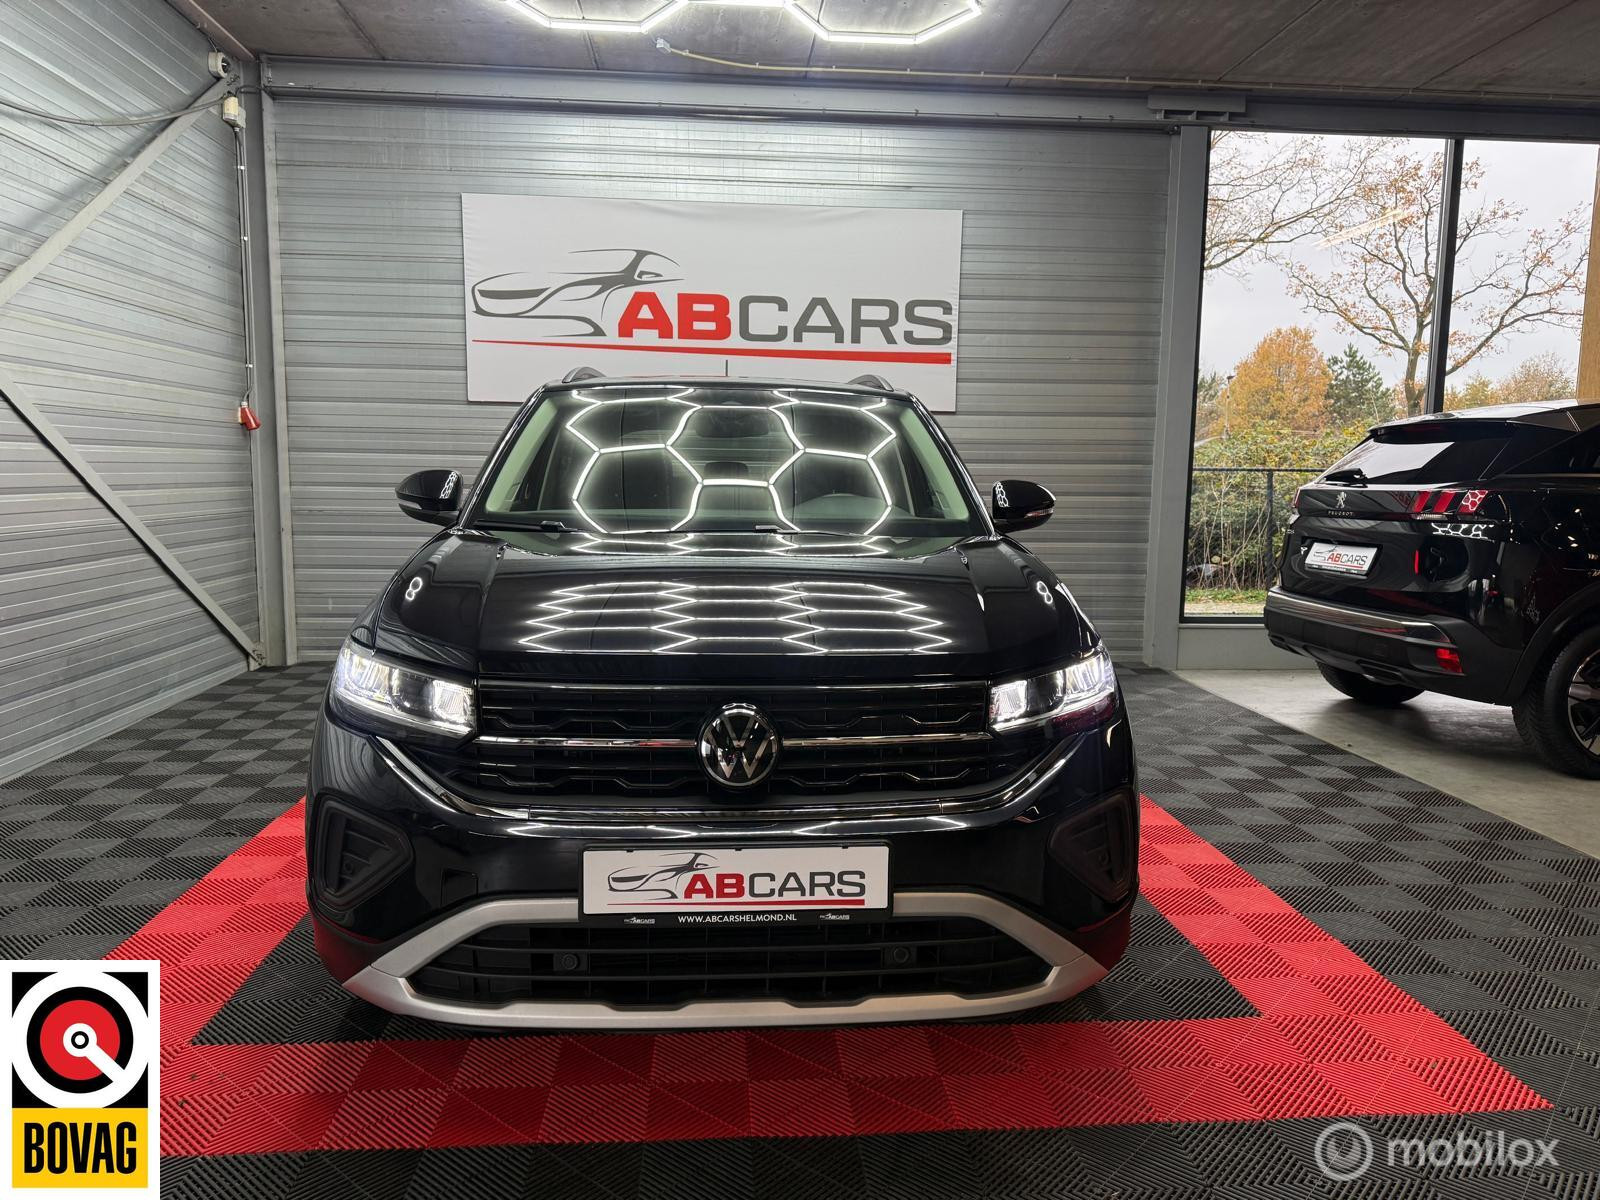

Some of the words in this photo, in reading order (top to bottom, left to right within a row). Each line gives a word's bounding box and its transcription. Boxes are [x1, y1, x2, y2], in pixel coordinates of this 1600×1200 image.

[617, 291, 954, 346] ABCARS
[1327, 551, 1368, 566] ABCARS
[684, 870, 866, 899] ABCARS
[677, 913, 797, 924] WWW.ABCARSHELMOND.NL
